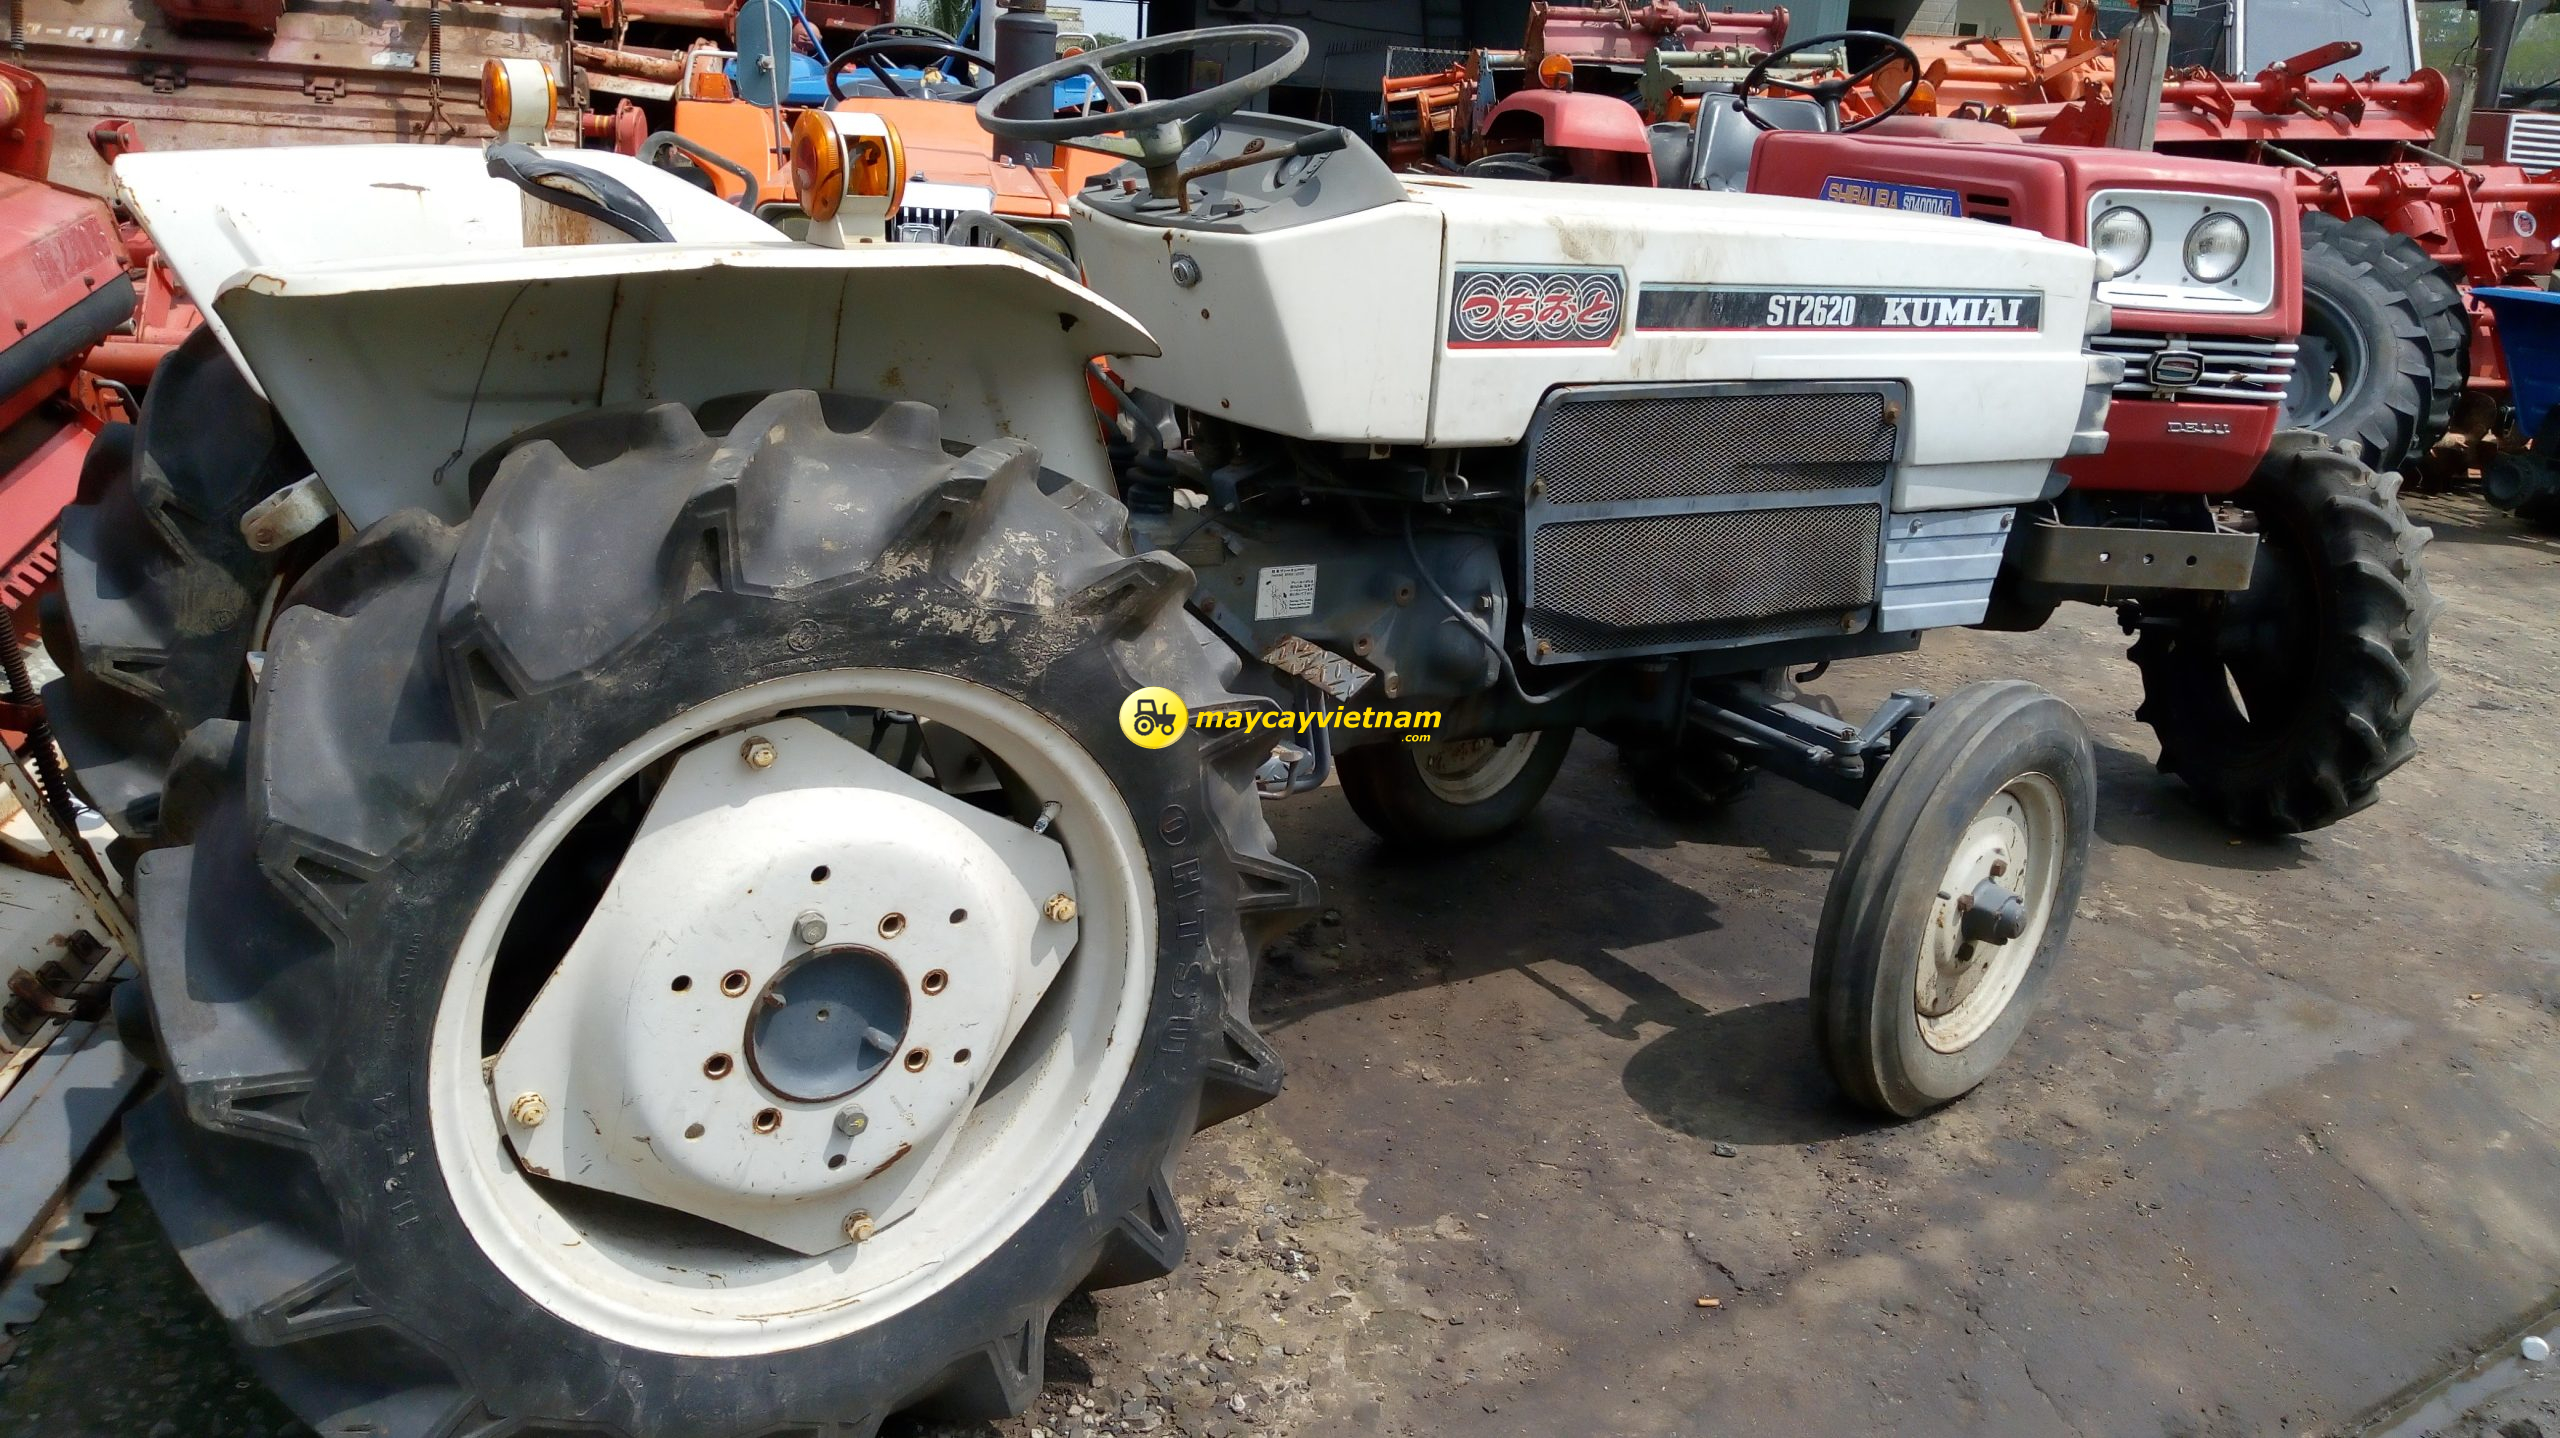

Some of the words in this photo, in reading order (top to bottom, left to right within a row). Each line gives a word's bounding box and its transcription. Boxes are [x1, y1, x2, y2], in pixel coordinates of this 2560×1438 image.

[1461, 289, 1615, 326] つちおと
[1766, 294, 1855, 326] ST2620
[1881, 296, 2023, 327] KUMIAI
